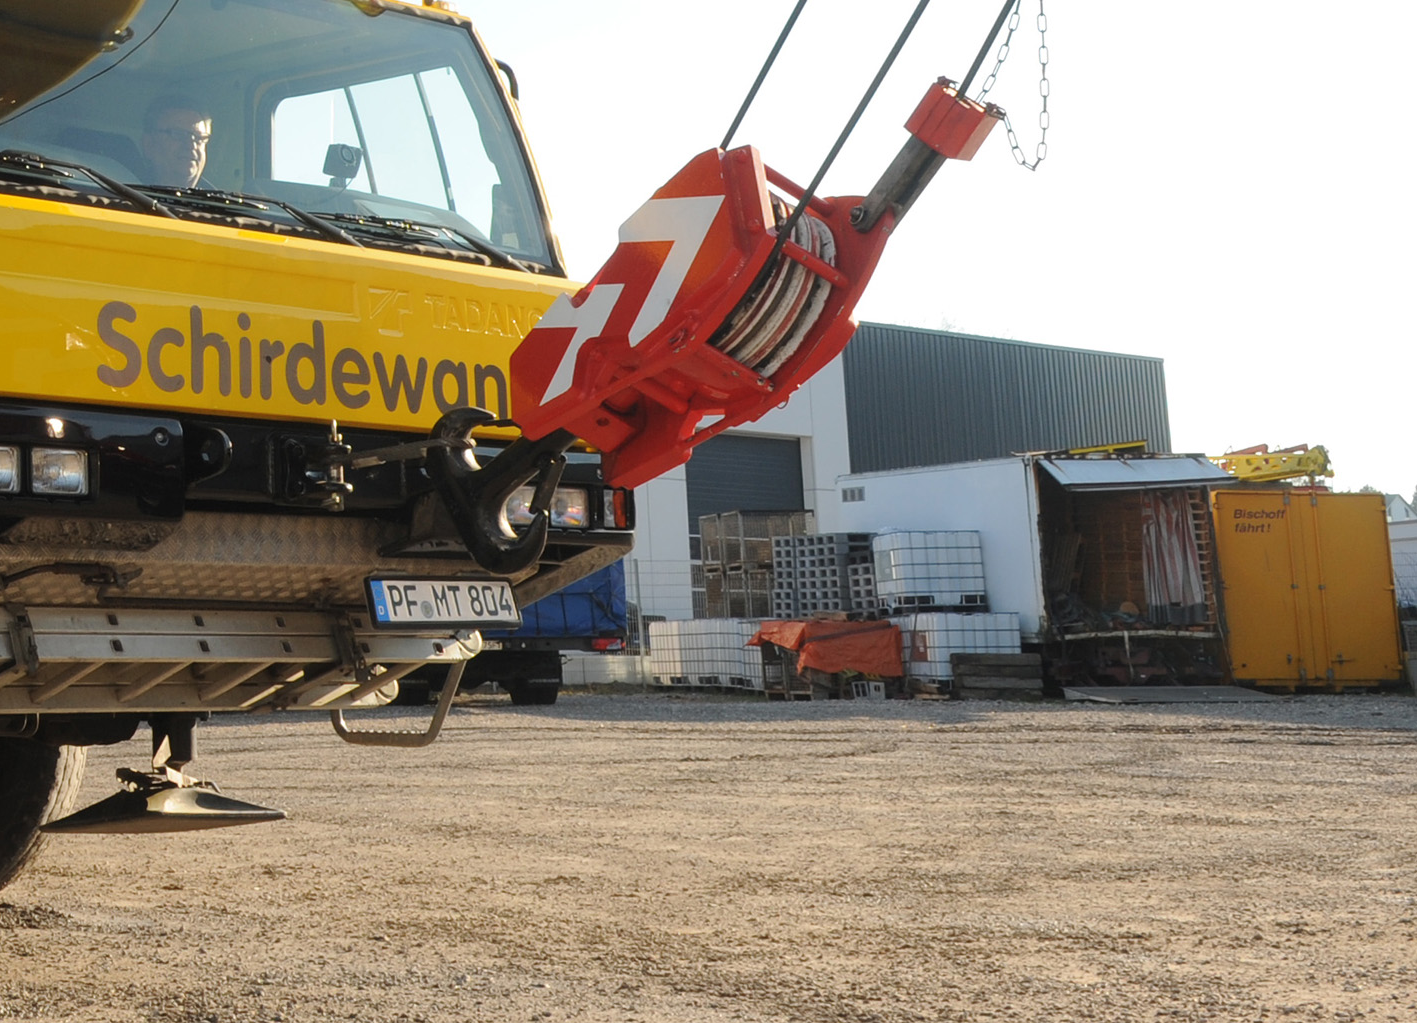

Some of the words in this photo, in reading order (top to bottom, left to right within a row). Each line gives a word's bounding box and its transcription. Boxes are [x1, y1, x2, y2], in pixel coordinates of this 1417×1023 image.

[97, 301, 509, 420] Schirdewan
[1234, 509, 1286, 519] Bischoff
[387, 585, 418, 616] PF
[431, 585, 461, 617] MT
[468, 585, 512, 616] 804
